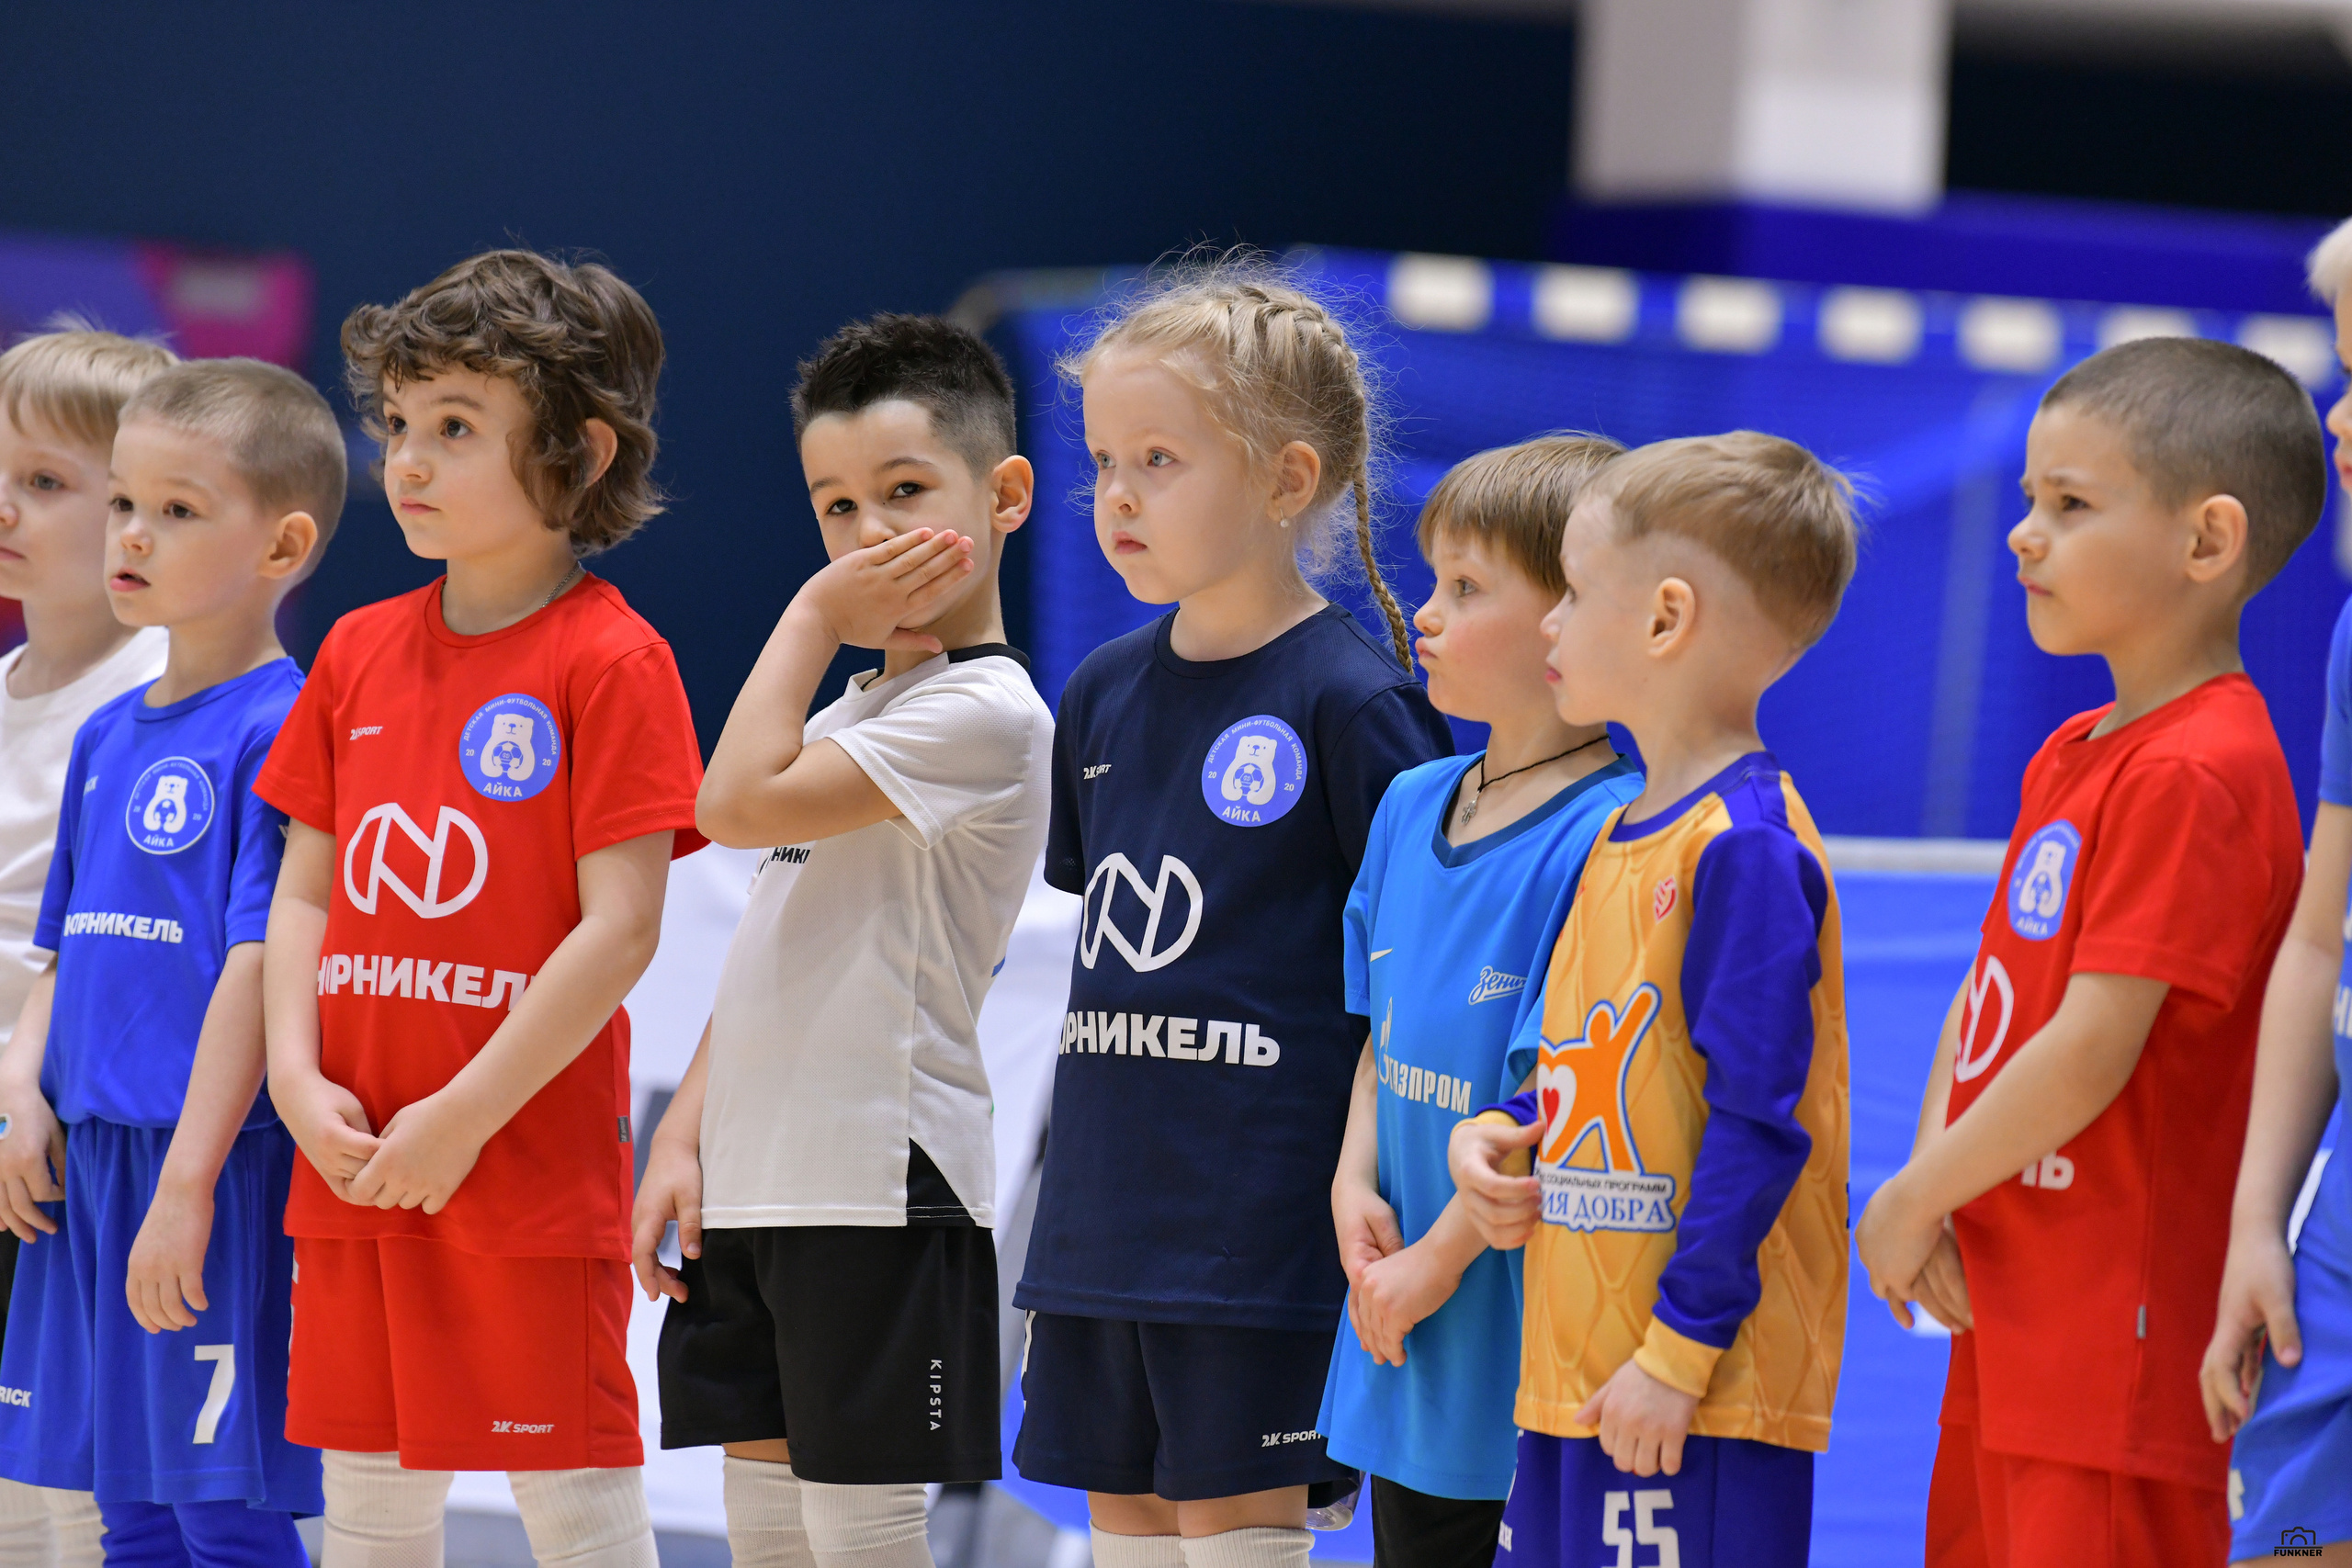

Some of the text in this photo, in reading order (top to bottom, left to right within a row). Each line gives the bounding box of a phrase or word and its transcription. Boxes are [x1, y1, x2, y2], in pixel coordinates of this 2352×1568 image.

[463, 698, 557, 755] ДЕТСКАЯ МИНИ-ФУТБОЛЬНАЯ КОМАНДА
[1207, 719, 1303, 780] ДЕТСКАЯ МИНИ-ФУТБОЛЬНАЯ КОМАНДА
[542, 758, 551, 766] 20
[1207, 771, 1217, 779] 20
[483, 782, 523, 797] АЙКА
[1283, 783, 1295, 792] 20
[1222, 806, 1261, 822] АЙКА
[143, 834, 175, 847] АЙКА
[1574, 1194, 1666, 1223] ДОБРА
[192, 1344, 236, 1445] 7
[930, 1359, 942, 1430] KIPSTA
[491, 1420, 555, 1434] 2K SPORT
[1261, 1432, 1282, 1448] 2K
[1601, 1489, 1681, 1568] 55
